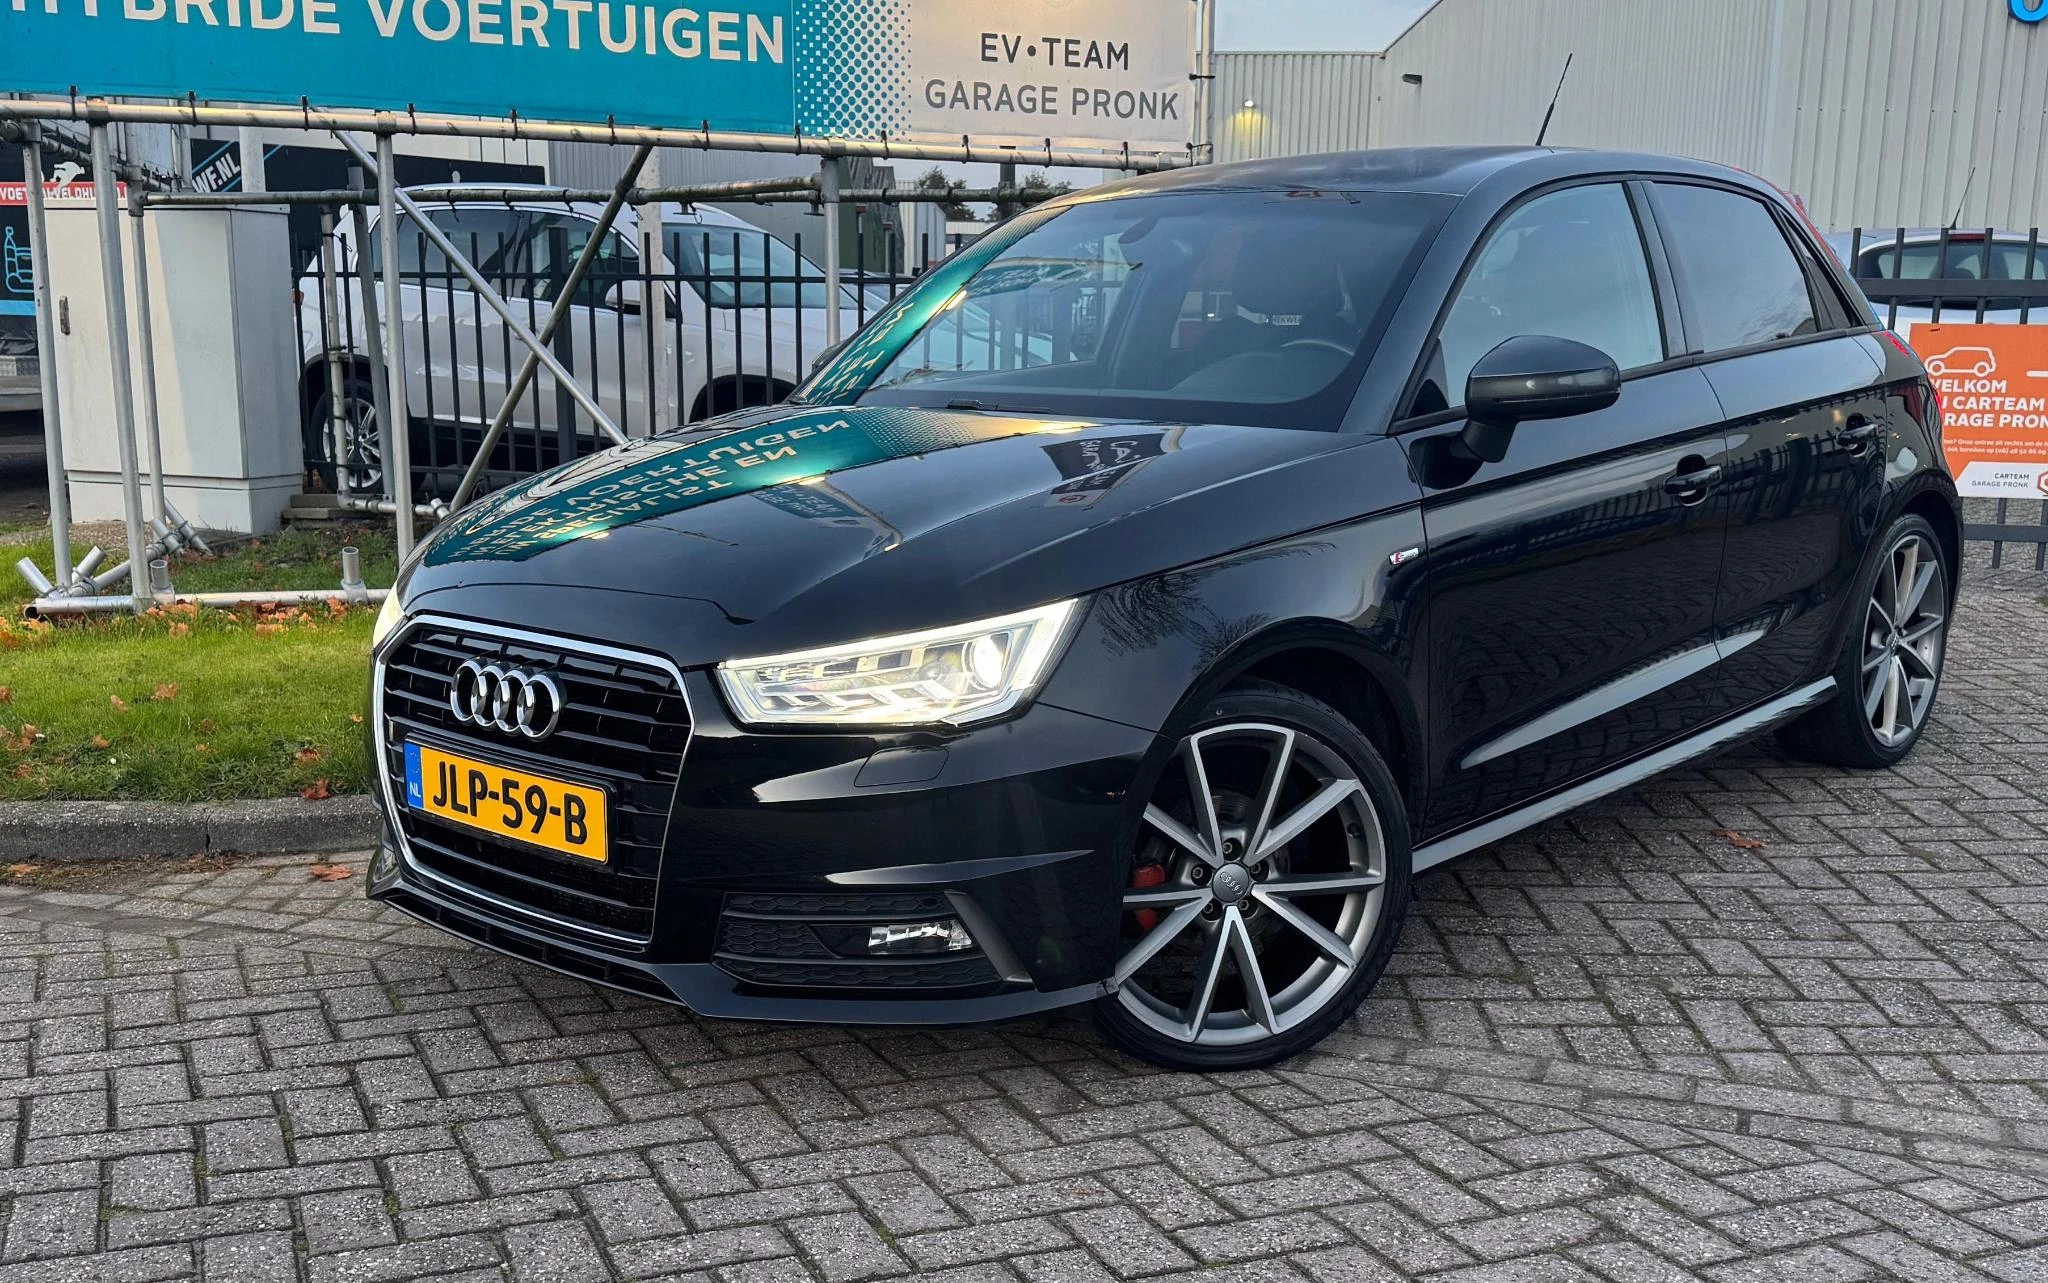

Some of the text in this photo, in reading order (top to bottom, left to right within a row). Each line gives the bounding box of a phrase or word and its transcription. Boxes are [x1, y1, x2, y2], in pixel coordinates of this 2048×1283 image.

[12, 0, 784, 65] RIDE VOERTUIGEN
[924, 78, 1179, 121] GARAGE PRONK
[1952, 396, 2046, 411] CARTEAM
[1971, 480, 2001, 488] GARAGE
[1994, 472, 2030, 480] CARTEAM
[409, 780, 422, 799] NL
[432, 760, 589, 846] JLP-59-B
